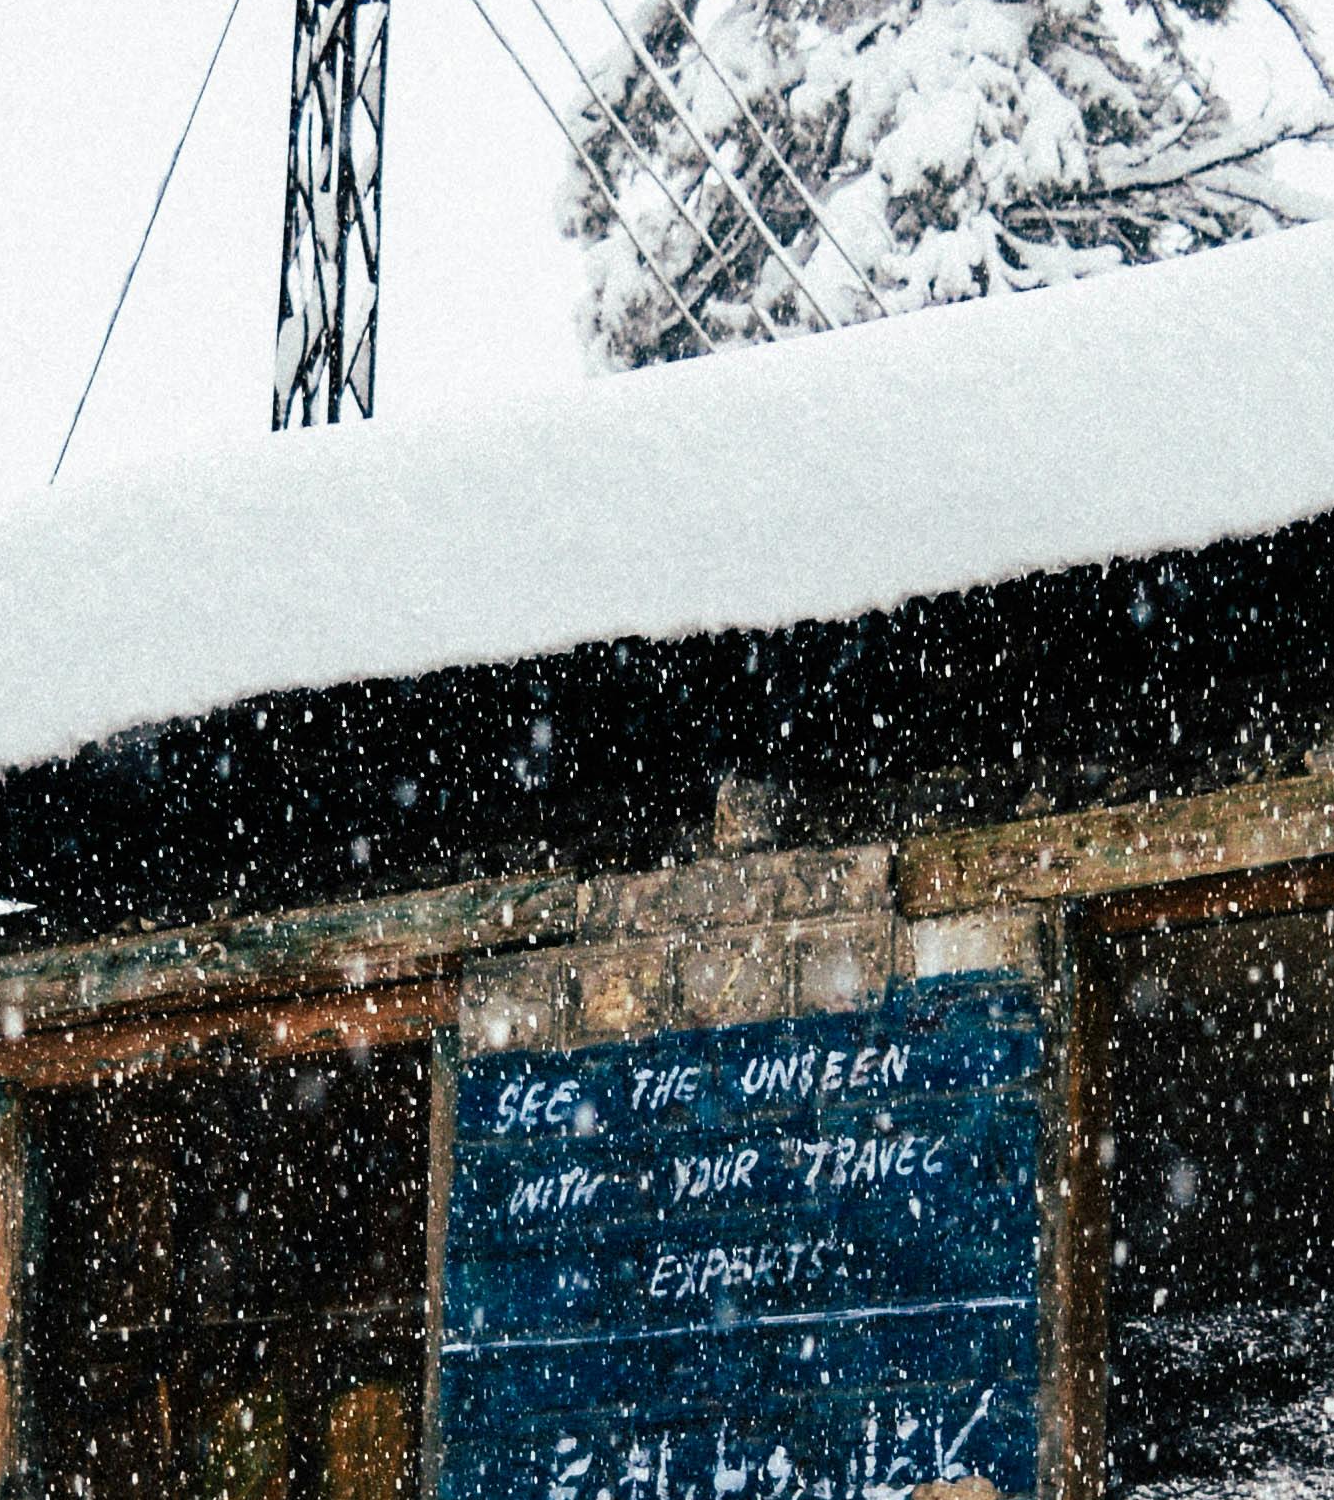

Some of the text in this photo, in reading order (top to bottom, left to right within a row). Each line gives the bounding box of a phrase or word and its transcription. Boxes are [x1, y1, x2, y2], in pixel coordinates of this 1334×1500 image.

[493, 1044, 912, 1134] SEE THE UNSEEN
[510, 1166, 604, 1216] WITH
[672, 1149, 759, 1202] YOUR
